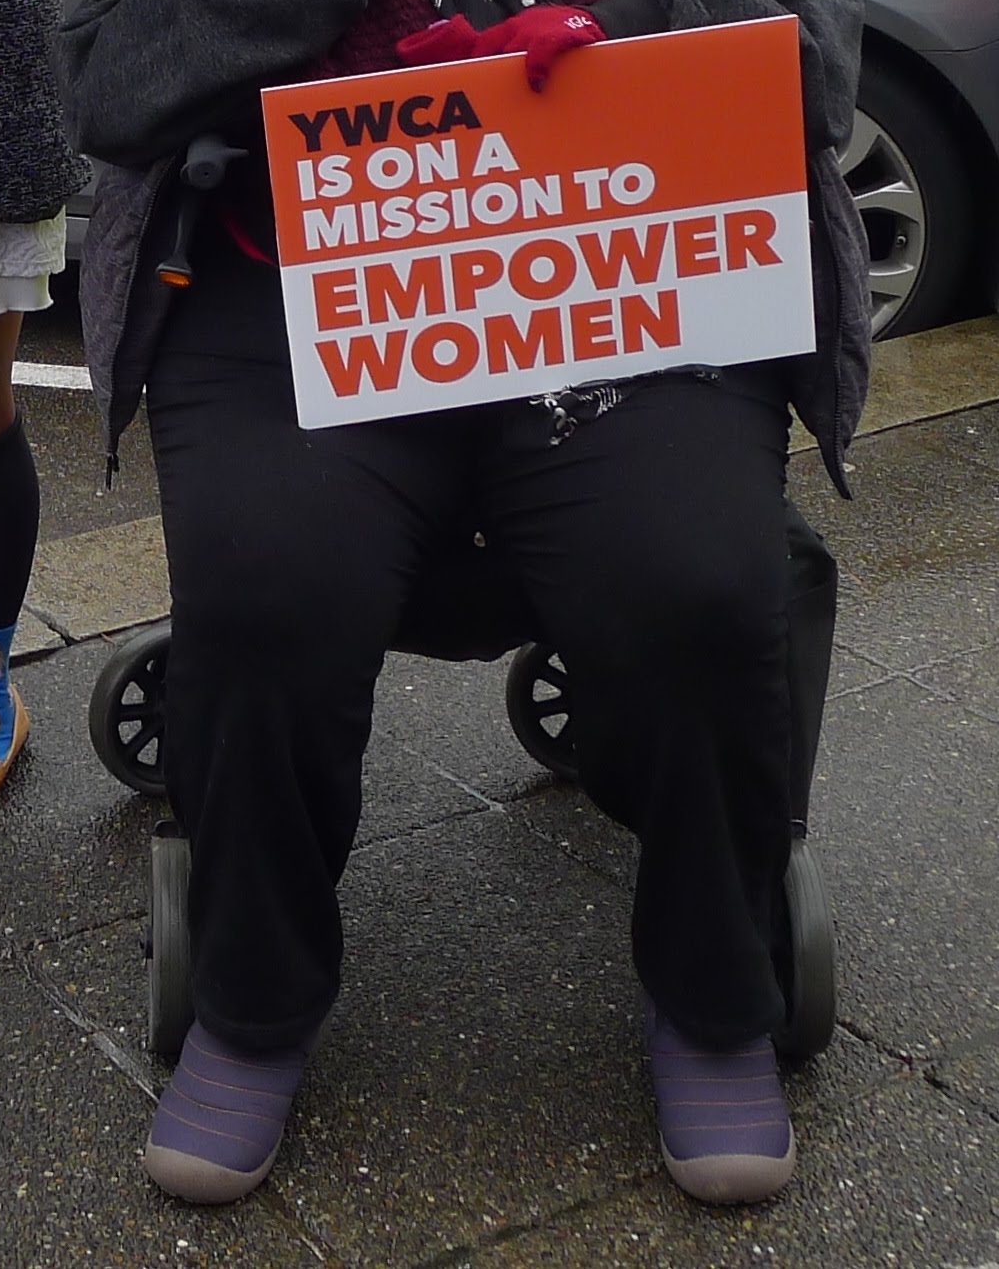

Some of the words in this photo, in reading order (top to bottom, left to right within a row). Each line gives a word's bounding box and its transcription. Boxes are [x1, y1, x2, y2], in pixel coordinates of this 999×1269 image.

[288, 90, 481, 153] YWCA
[296, 155, 353, 202] IS
[367, 139, 460, 192] ON
[473, 132, 520, 176] A
[302, 174, 564, 251] MISSION
[573, 163, 656, 211] TO
[312, 209, 784, 332] EMPOWER
[315, 289, 682, 398] WOMEN
